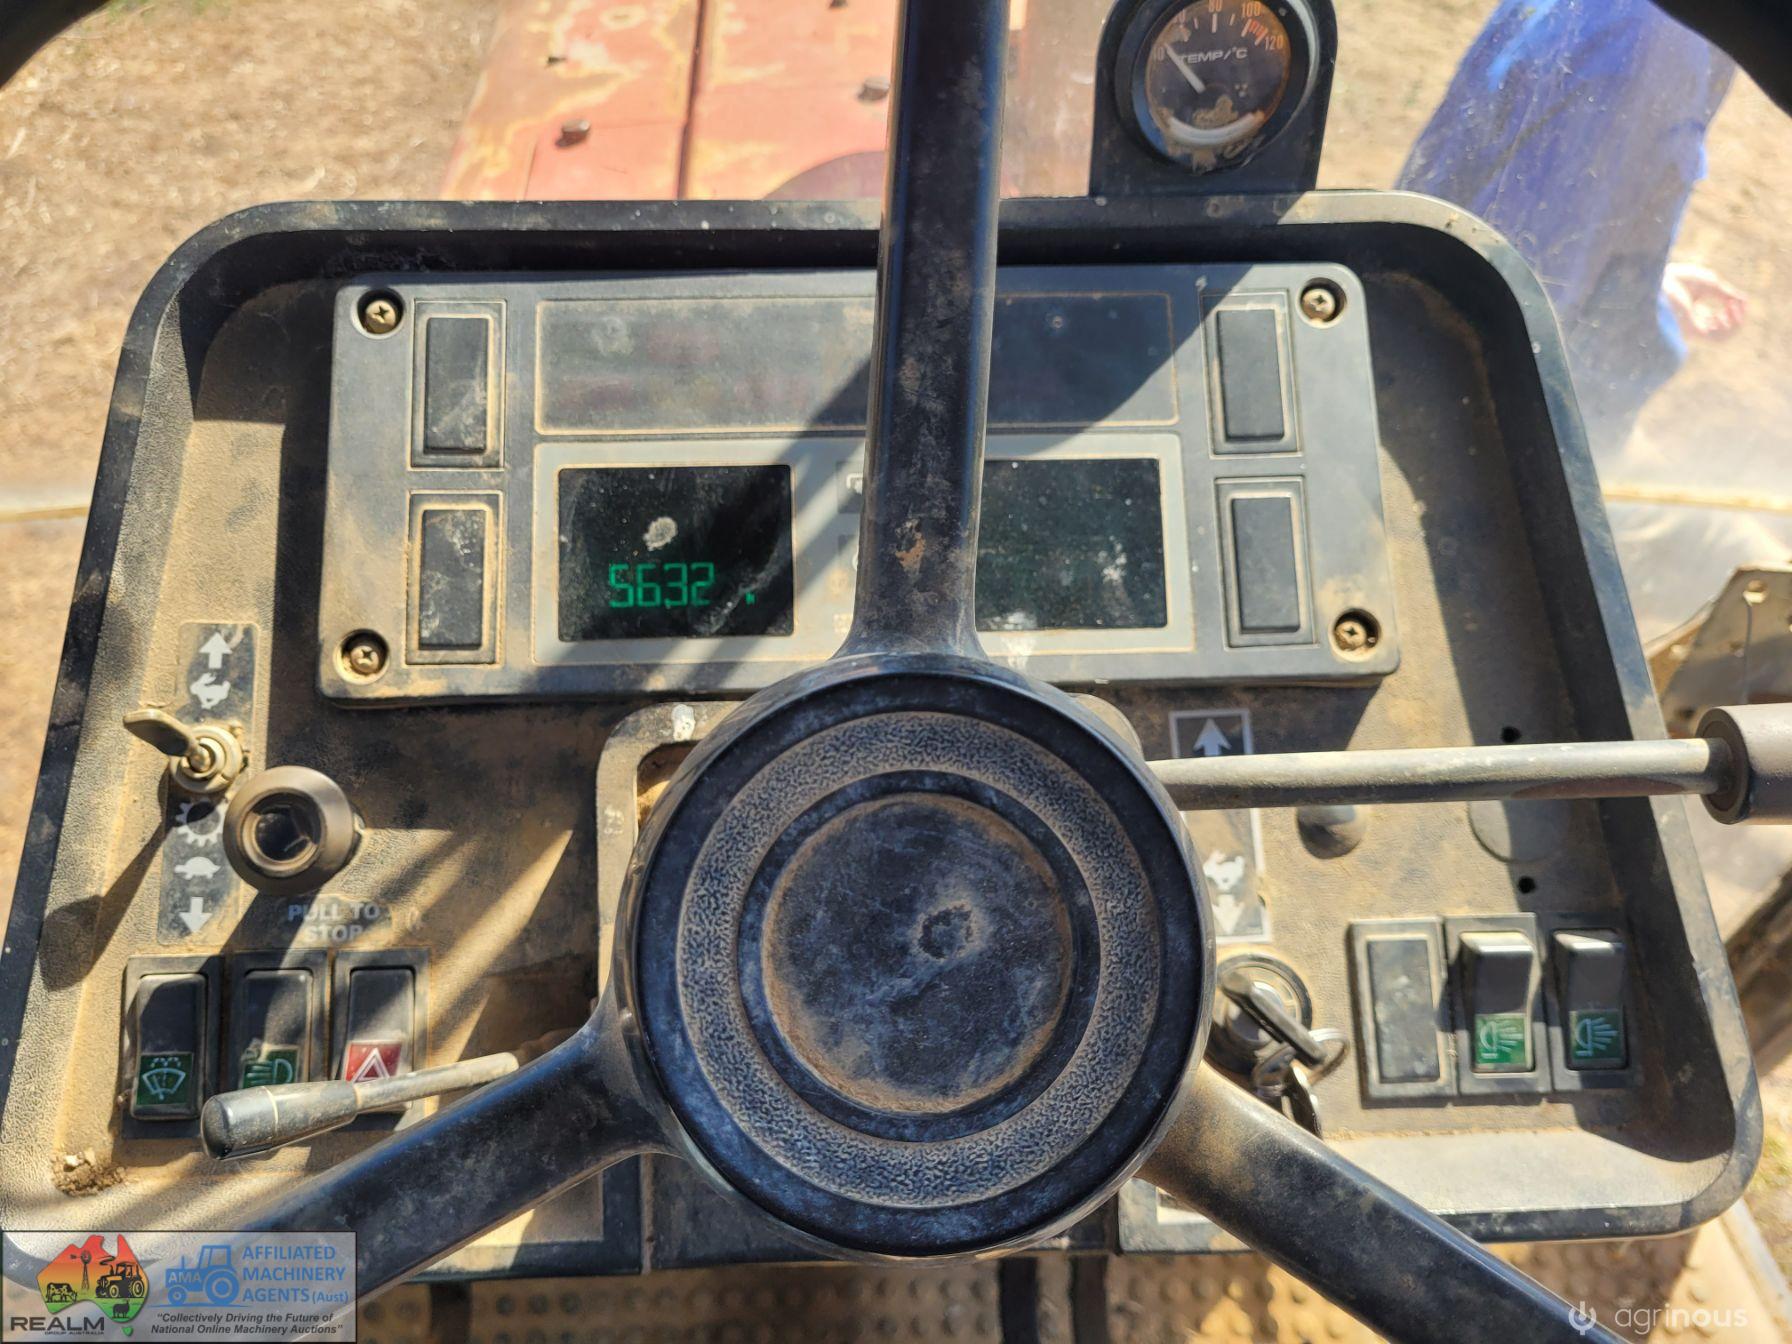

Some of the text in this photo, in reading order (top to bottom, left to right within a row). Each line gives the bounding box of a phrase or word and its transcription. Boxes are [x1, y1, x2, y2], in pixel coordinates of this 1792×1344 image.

[1241, 1, 1261, 18] 100
[1264, 34, 1284, 51] 120
[608, 562, 716, 608] 5632
[287, 901, 381, 922] PULL TO
[303, 923, 364, 943] STOP
